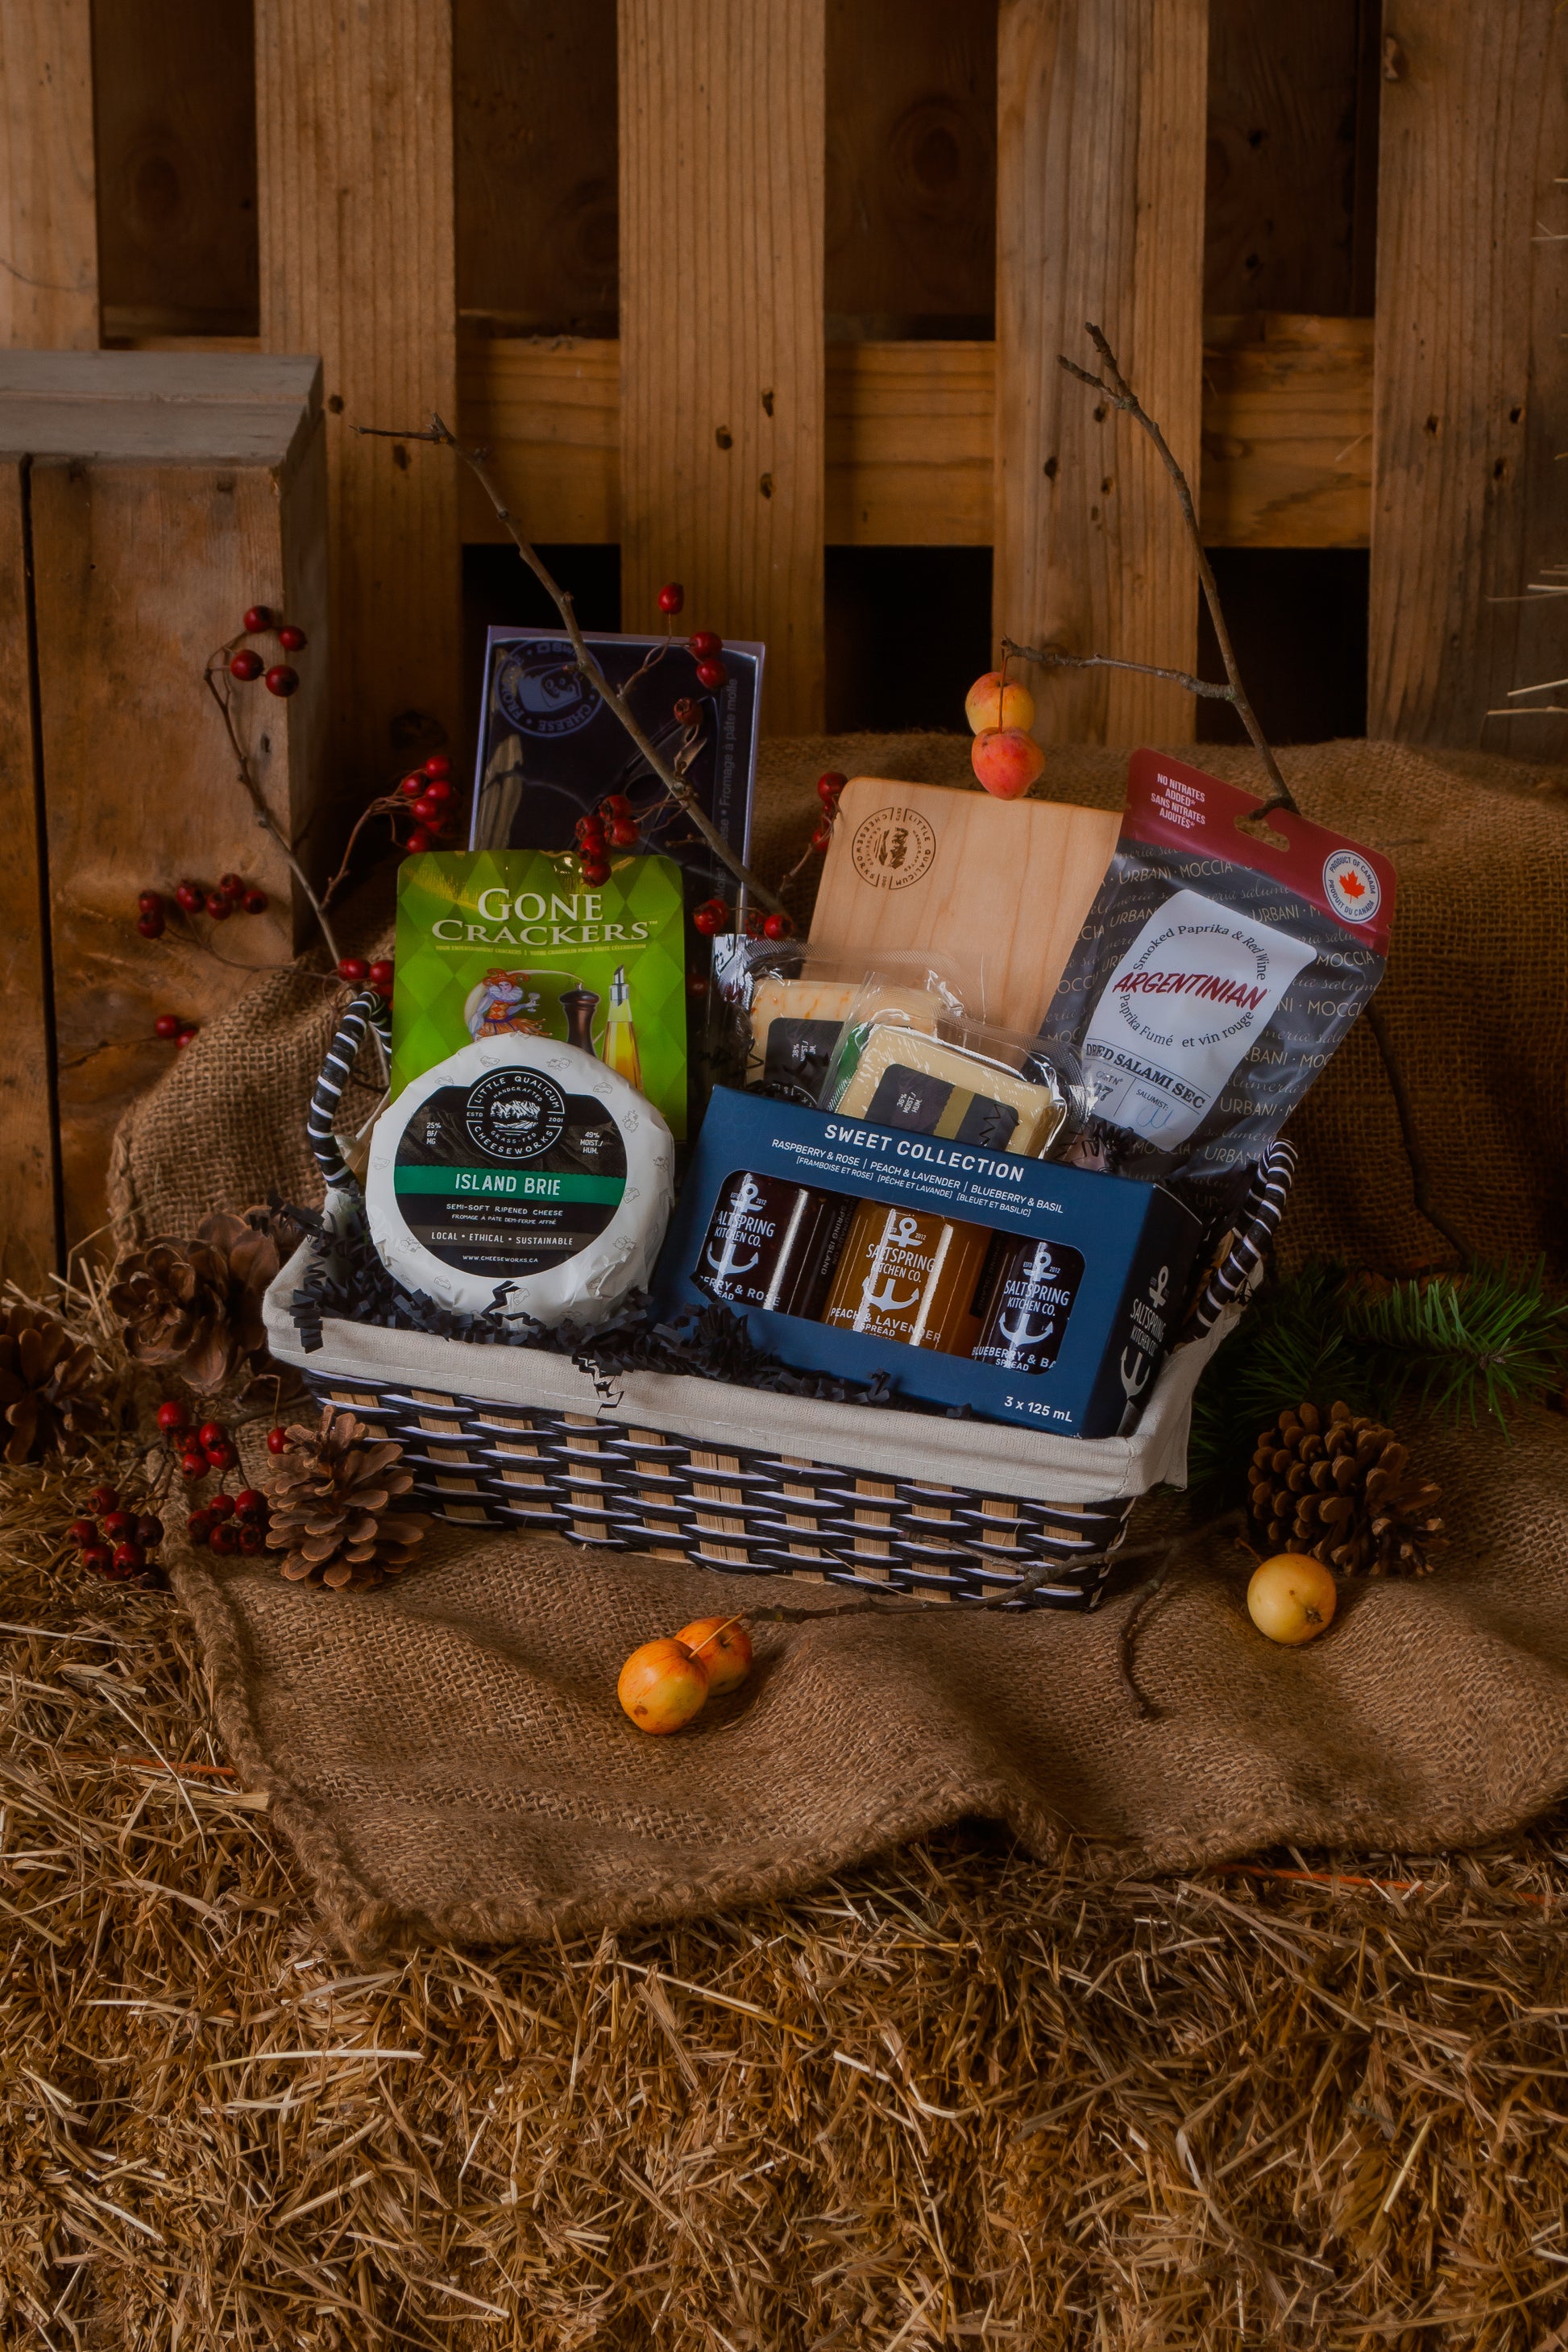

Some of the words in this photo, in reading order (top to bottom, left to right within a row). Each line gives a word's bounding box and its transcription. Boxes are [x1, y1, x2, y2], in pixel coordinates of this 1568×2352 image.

[724, 678, 737, 710] molle
[537, 703, 591, 732] CHEESE
[722, 714, 736, 740] pâte
[720, 754, 734, 806] Fromage
[1157, 774, 1168, 786] NO
[1169, 778, 1205, 803] NITRATES
[1151, 793, 1171, 809] SANS
[1172, 800, 1206, 825] NITRATES
[908, 815, 931, 841] LITTLE
[856, 814, 887, 878] CHEESEWORKS
[895, 849, 931, 886] QUALICUM
[1119, 866, 1171, 885] URBANI
[1179, 860, 1233, 878] MOCCIA
[1329, 856, 1351, 873] PRODUCT
[1353, 859, 1361, 867] OF
[1361, 865, 1376, 894] CANADA
[477, 887, 604, 922] GONE
[1329, 879, 1345, 908] PRODUIT
[1344, 906, 1353, 915] DU
[1354, 900, 1375, 916] CANADA
[1252, 904, 1299, 923] URBANI
[1133, 928, 1175, 970] Smoked
[1177, 924, 1230, 936] Paprika
[1231, 931, 1244, 941] &
[1242, 936, 1263, 954] Red
[1255, 952, 1270, 981] Wine
[1317, 951, 1375, 968] MOCCIA
[1113, 972, 1267, 1010] ARGENTINIAN
[1119, 993, 1141, 1031] Paprika
[1139, 1026, 1173, 1047] Fumé
[1182, 1037, 1195, 1047] et
[1200, 1033, 1220, 1046] vin
[1223, 1011, 1255, 1039] rouge
[1307, 1001, 1363, 1018] MOCCI
[791, 1043, 799, 1059] 38%
[475, 1077, 507, 1104] LITTLE
[515, 1076, 560, 1109] QUALICUM
[493, 1086, 543, 1102] HANDCRAFTED
[1114, 1054, 1174, 1089] SALAMI
[1172, 1083, 1206, 1109] SEC
[1220, 1096, 1276, 1117] URBANI
[426, 1130, 438, 1138] BF/
[474, 1126, 554, 1155] CHEESEWORKS
[491, 1130, 537, 1144] GRASS-FED
[583, 1147, 599, 1155] HUM.
[823, 1124, 894, 1152] SWEET
[896, 1140, 1025, 1183] COLLECTION
[454, 1173, 516, 1193] ISLAND
[524, 1176, 562, 1196] BRIE
[771, 1139, 827, 1159] RASPBERRY
[827, 1151, 834, 1160] &
[835, 1153, 861, 1168] ROSE
[869, 1161, 902, 1176] PEACH
[902, 1168, 911, 1177] &
[911, 1171, 961, 1190] LAVENDER
[970, 1184, 1027, 1205] BLUEBERRY
[1028, 1197, 1035, 1206] &
[1036, 1199, 1064, 1214] BASIL
[796, 1155, 840, 1173] [FRAMBOISE
[840, 1166, 851, 1176] ET
[851, 1169, 873, 1181] ROSE]
[905, 1180, 915, 1190] ET
[915, 1183, 953, 1200] LAVANDE]
[956, 1193, 989, 1209] [BLEUET
[989, 1200, 999, 1209] ET
[999, 1202, 1031, 1218] BASILIC]
[446, 1203, 491, 1213] SEMI-SOFT
[495, 1206, 529, 1215] RIPENED
[533, 1208, 563, 1217] CHEESE
[756, 1197, 768, 1206] 2012
[451, 1213, 479, 1222] FROMAGE
[712, 1209, 777, 1238] SALTSPRING
[431, 1231, 458, 1242] LOCAL
[469, 1234, 504, 1243] ETHICAL
[516, 1236, 574, 1246] SUSTAINABLE
[714, 1226, 747, 1243] KITCHEN
[748, 1234, 761, 1247] CO.
[915, 1232, 927, 1242] 2012
[463, 1254, 538, 1263] WWW.CHEESEWORKS.CA
[819, 1240, 836, 1276] ISLAND
[865, 1243, 936, 1274] SALTSPRING
[907, 1269, 922, 1283] CO.
[734, 1284, 745, 1296] &
[1004, 1280, 1071, 1306] SALTSPRING
[831, 1307, 860, 1321] PEACH
[1007, 1296, 1041, 1313] KITCHEN
[1042, 1303, 1056, 1317] CO.
[1130, 1297, 1167, 1343] SALTSPRING
[1130, 1324, 1152, 1352] KITCHEN
[1027, 1354, 1036, 1365] &
[1004, 1396, 1014, 1408] 3
[1015, 1401, 1025, 1411] x
[1027, 1400, 1052, 1417] 125
[1054, 1407, 1073, 1423] mL
